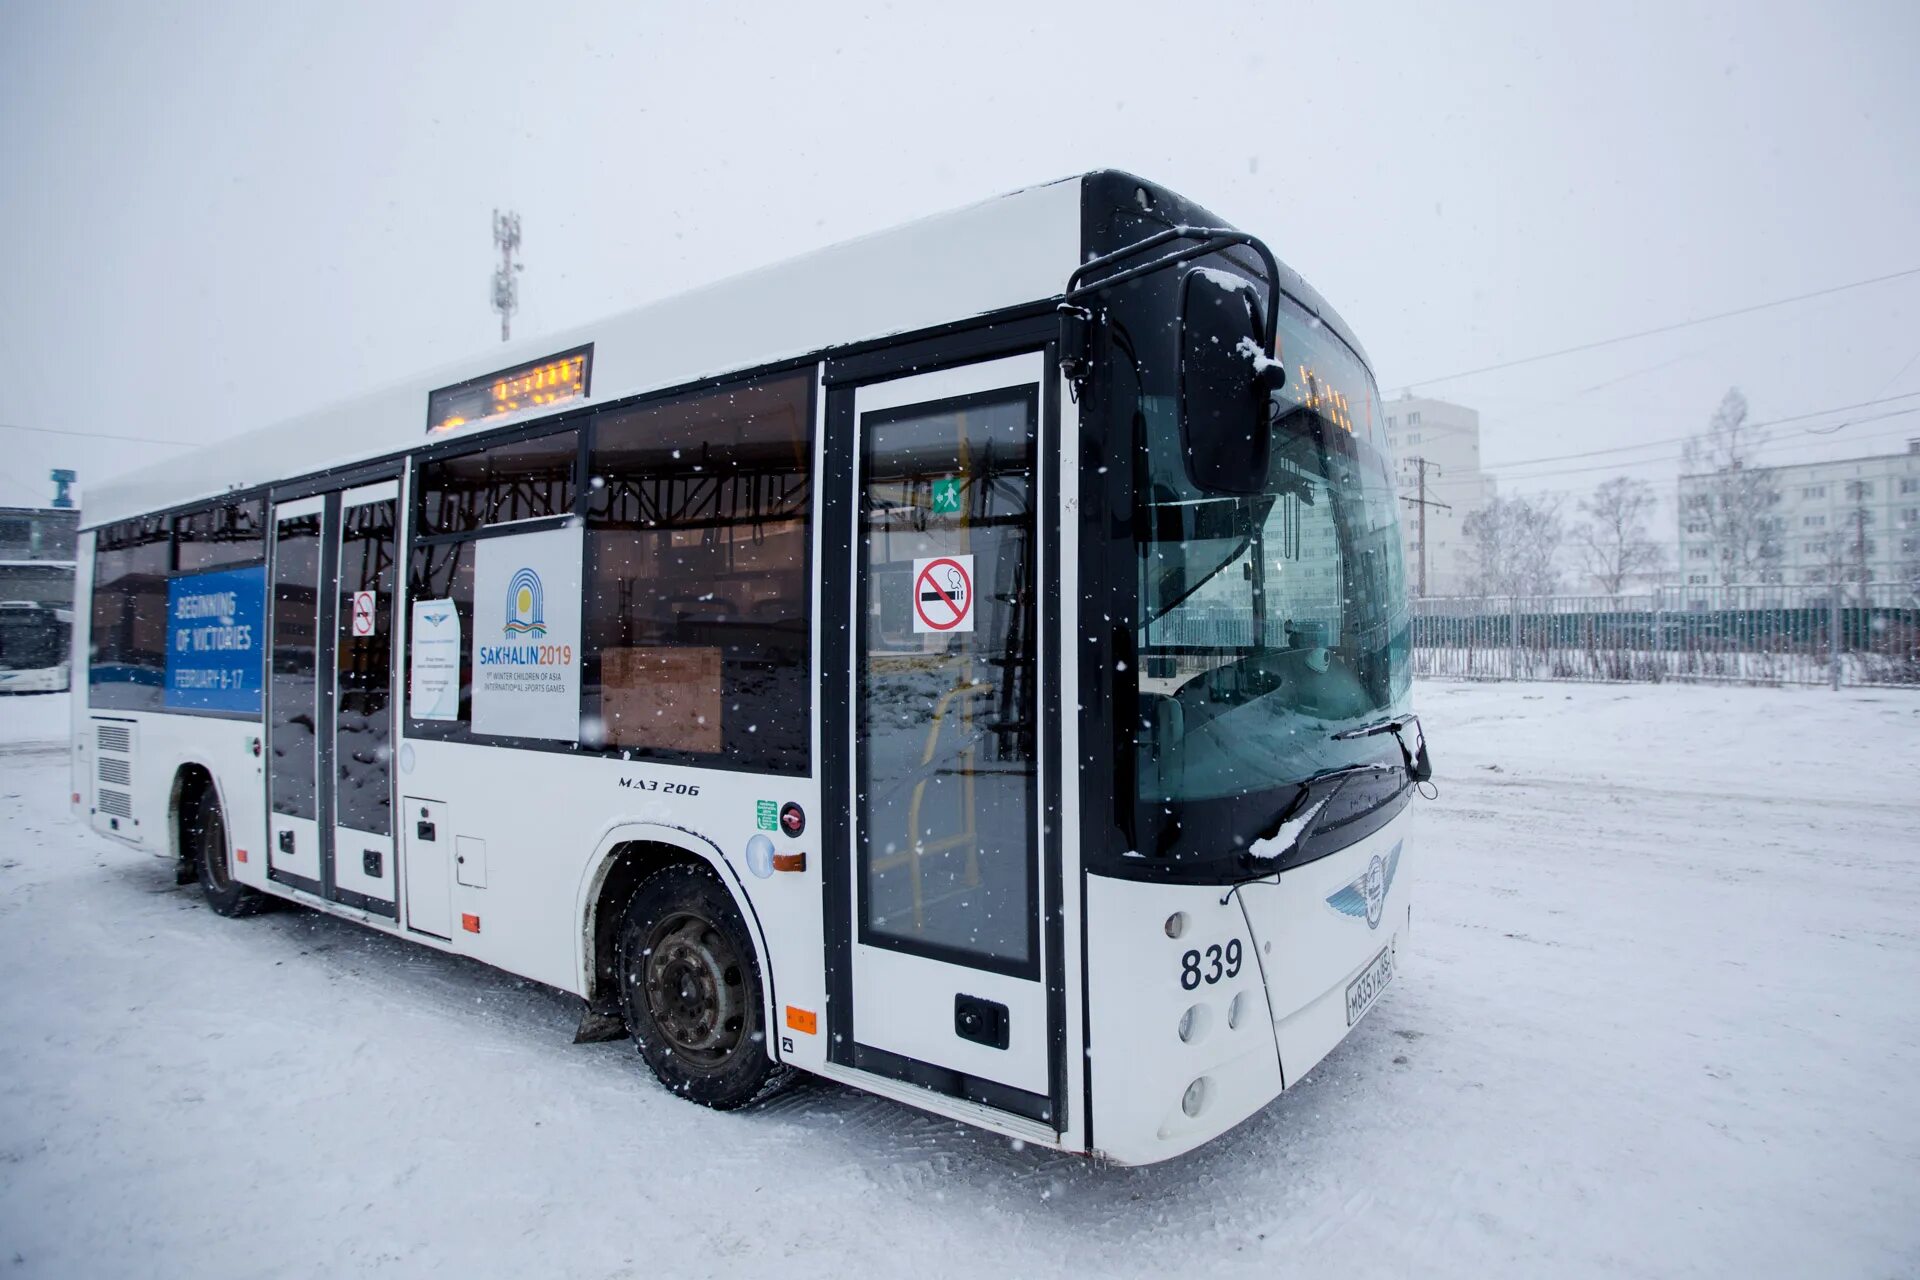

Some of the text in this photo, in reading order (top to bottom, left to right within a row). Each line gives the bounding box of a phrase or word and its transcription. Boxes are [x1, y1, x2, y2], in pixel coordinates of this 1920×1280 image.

[177, 592, 237, 619] BEGINNING
[176, 625, 251, 651] OF VICTORIES
[175, 669, 218, 689] FEBRUARY
[493, 671, 512, 681] WINTER
[513, 672, 539, 681] CHILDREN
[540, 672, 549, 680] OF
[549, 672, 562, 681] ASIA
[484, 682, 566, 693] INTERNATIONAL SPORTS GAMES
[663, 782, 700, 796] 206
[1181, 938, 1242, 991] 839
